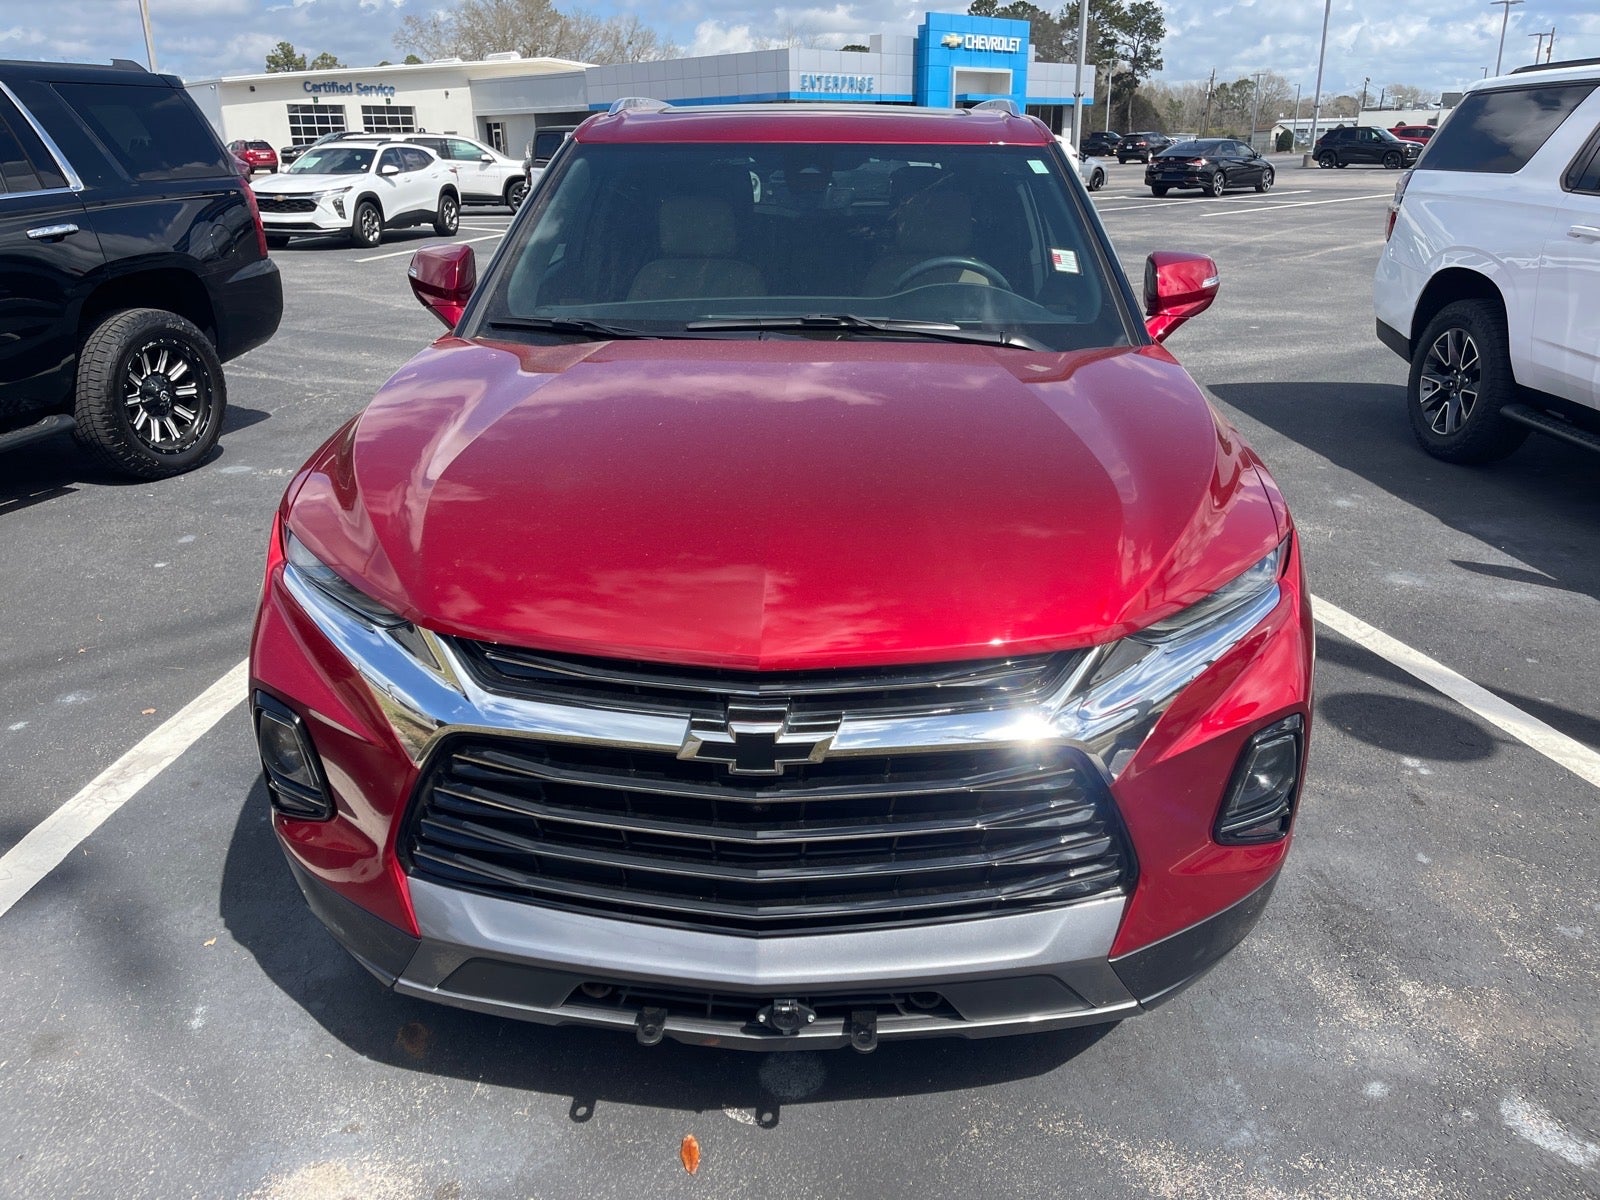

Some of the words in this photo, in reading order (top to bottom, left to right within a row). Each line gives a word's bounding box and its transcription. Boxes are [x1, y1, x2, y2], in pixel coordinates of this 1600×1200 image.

[965, 35, 1022, 52] CHEVROLET
[303, 81, 353, 93] Certified
[356, 83, 396, 96] Service
[800, 73, 875, 92] ENTERPRISE
